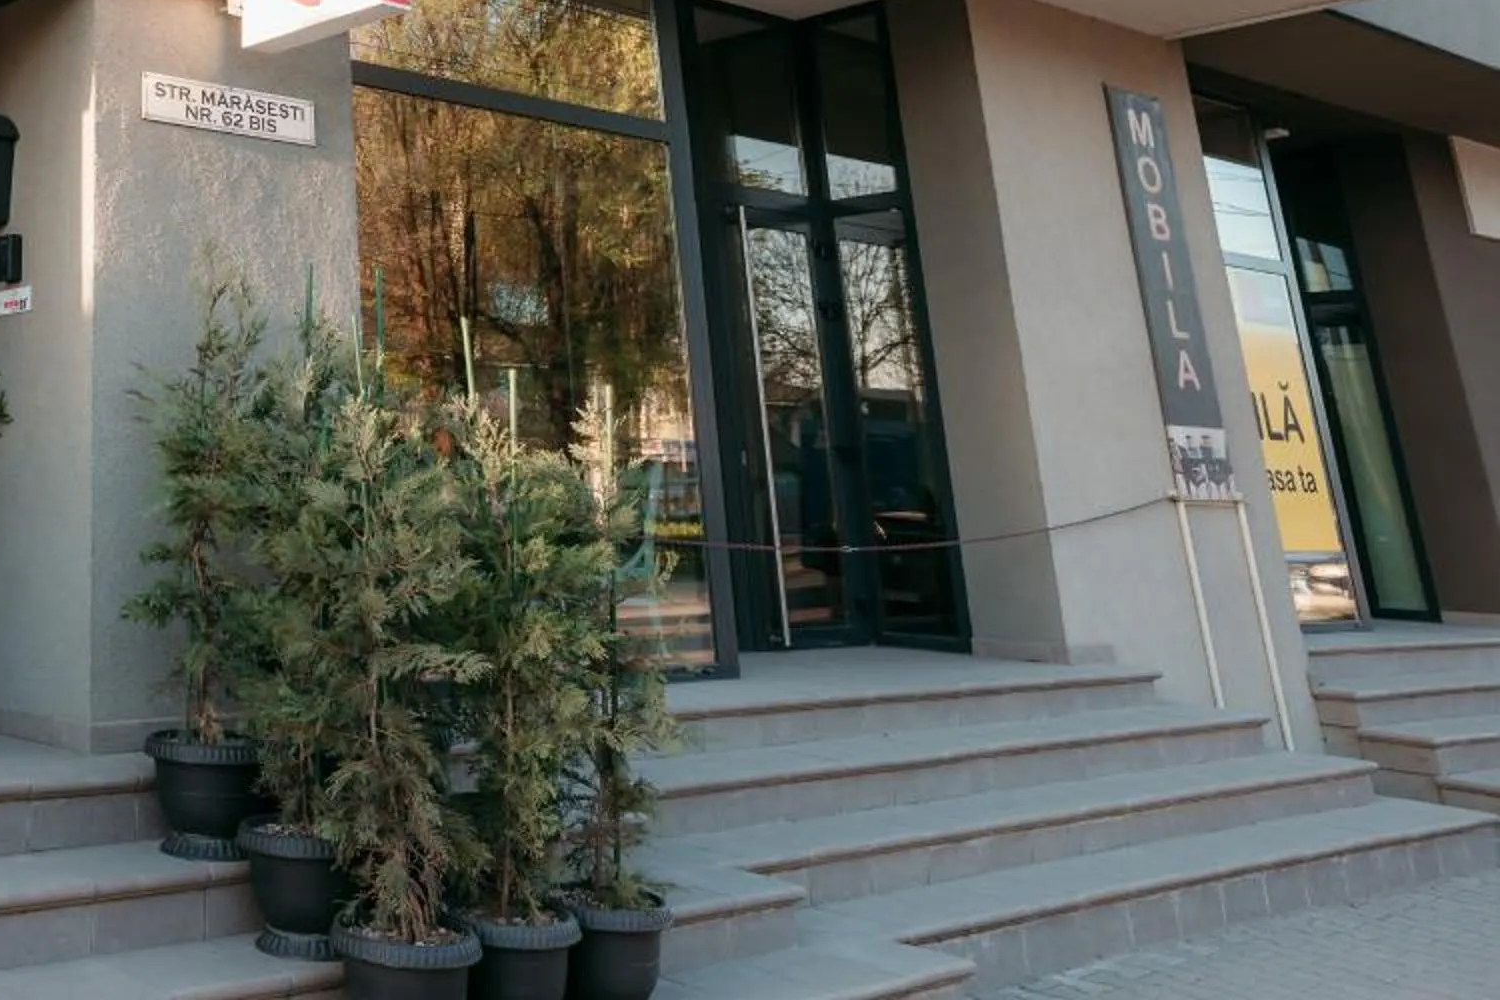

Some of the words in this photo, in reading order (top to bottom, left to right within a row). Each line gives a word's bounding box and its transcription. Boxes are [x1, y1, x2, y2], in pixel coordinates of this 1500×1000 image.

[155, 81, 197, 103] STR.
[185, 106, 218, 124] NR.
[221, 111, 244, 128] 62
[250, 115, 277, 133] BIS
[1127, 108, 1202, 392] MOBILA
[1298, 464, 1318, 493] ta
